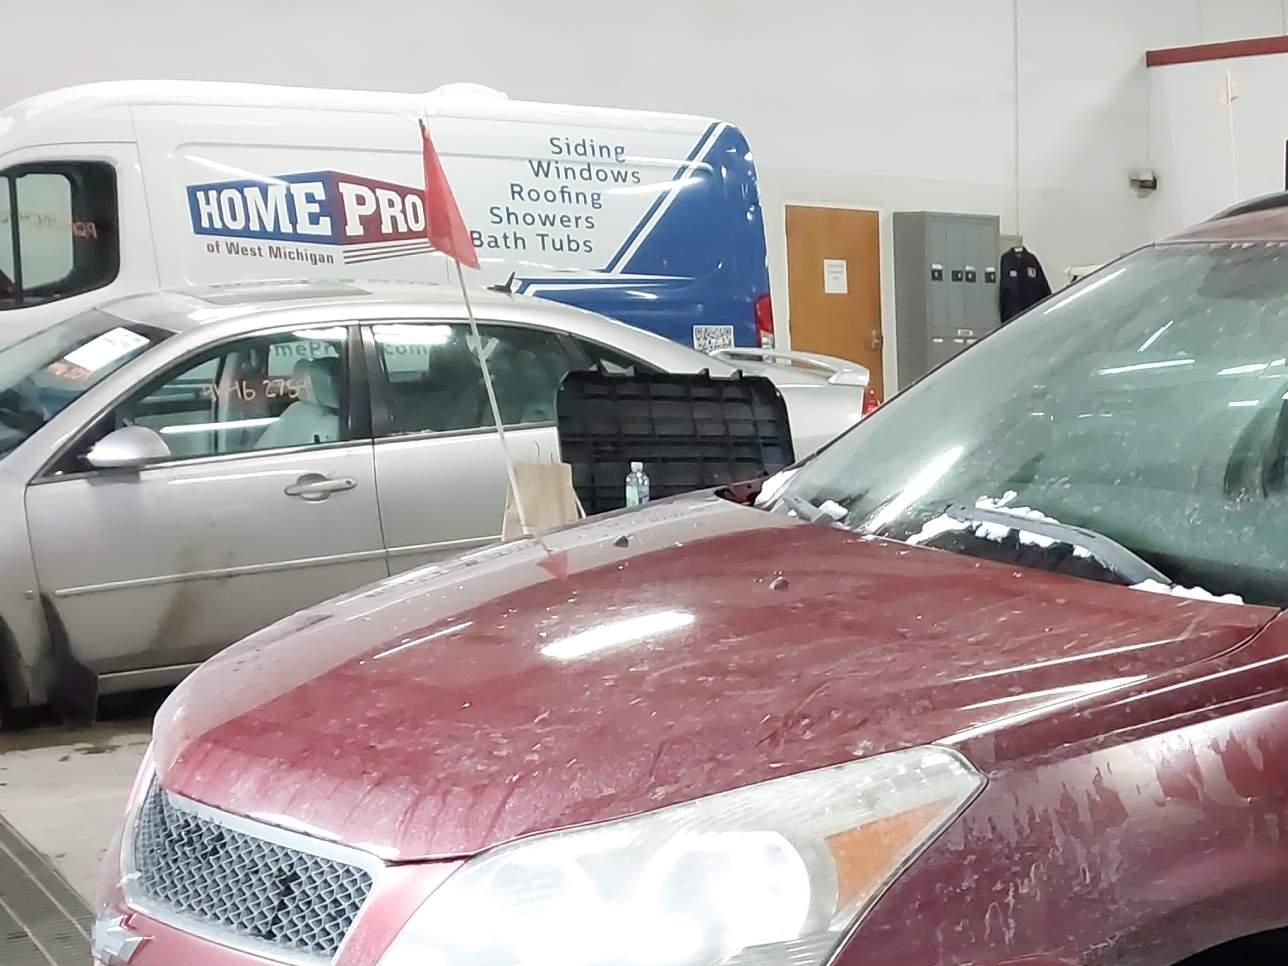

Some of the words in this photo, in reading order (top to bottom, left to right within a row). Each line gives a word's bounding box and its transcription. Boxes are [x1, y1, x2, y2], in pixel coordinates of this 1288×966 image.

[549, 136, 626, 163] Siding
[529, 159, 642, 184] Windows
[196, 181, 332, 236] HOME
[338, 181, 426, 236] PRO
[510, 182, 603, 210] Roofing
[489, 206, 596, 229] Showers
[206, 241, 221, 254] of
[225, 241, 264, 258] West
[269, 245, 335, 266] Michigan
[470, 230, 527, 251] Bath
[536, 233, 593, 253] Tubs
